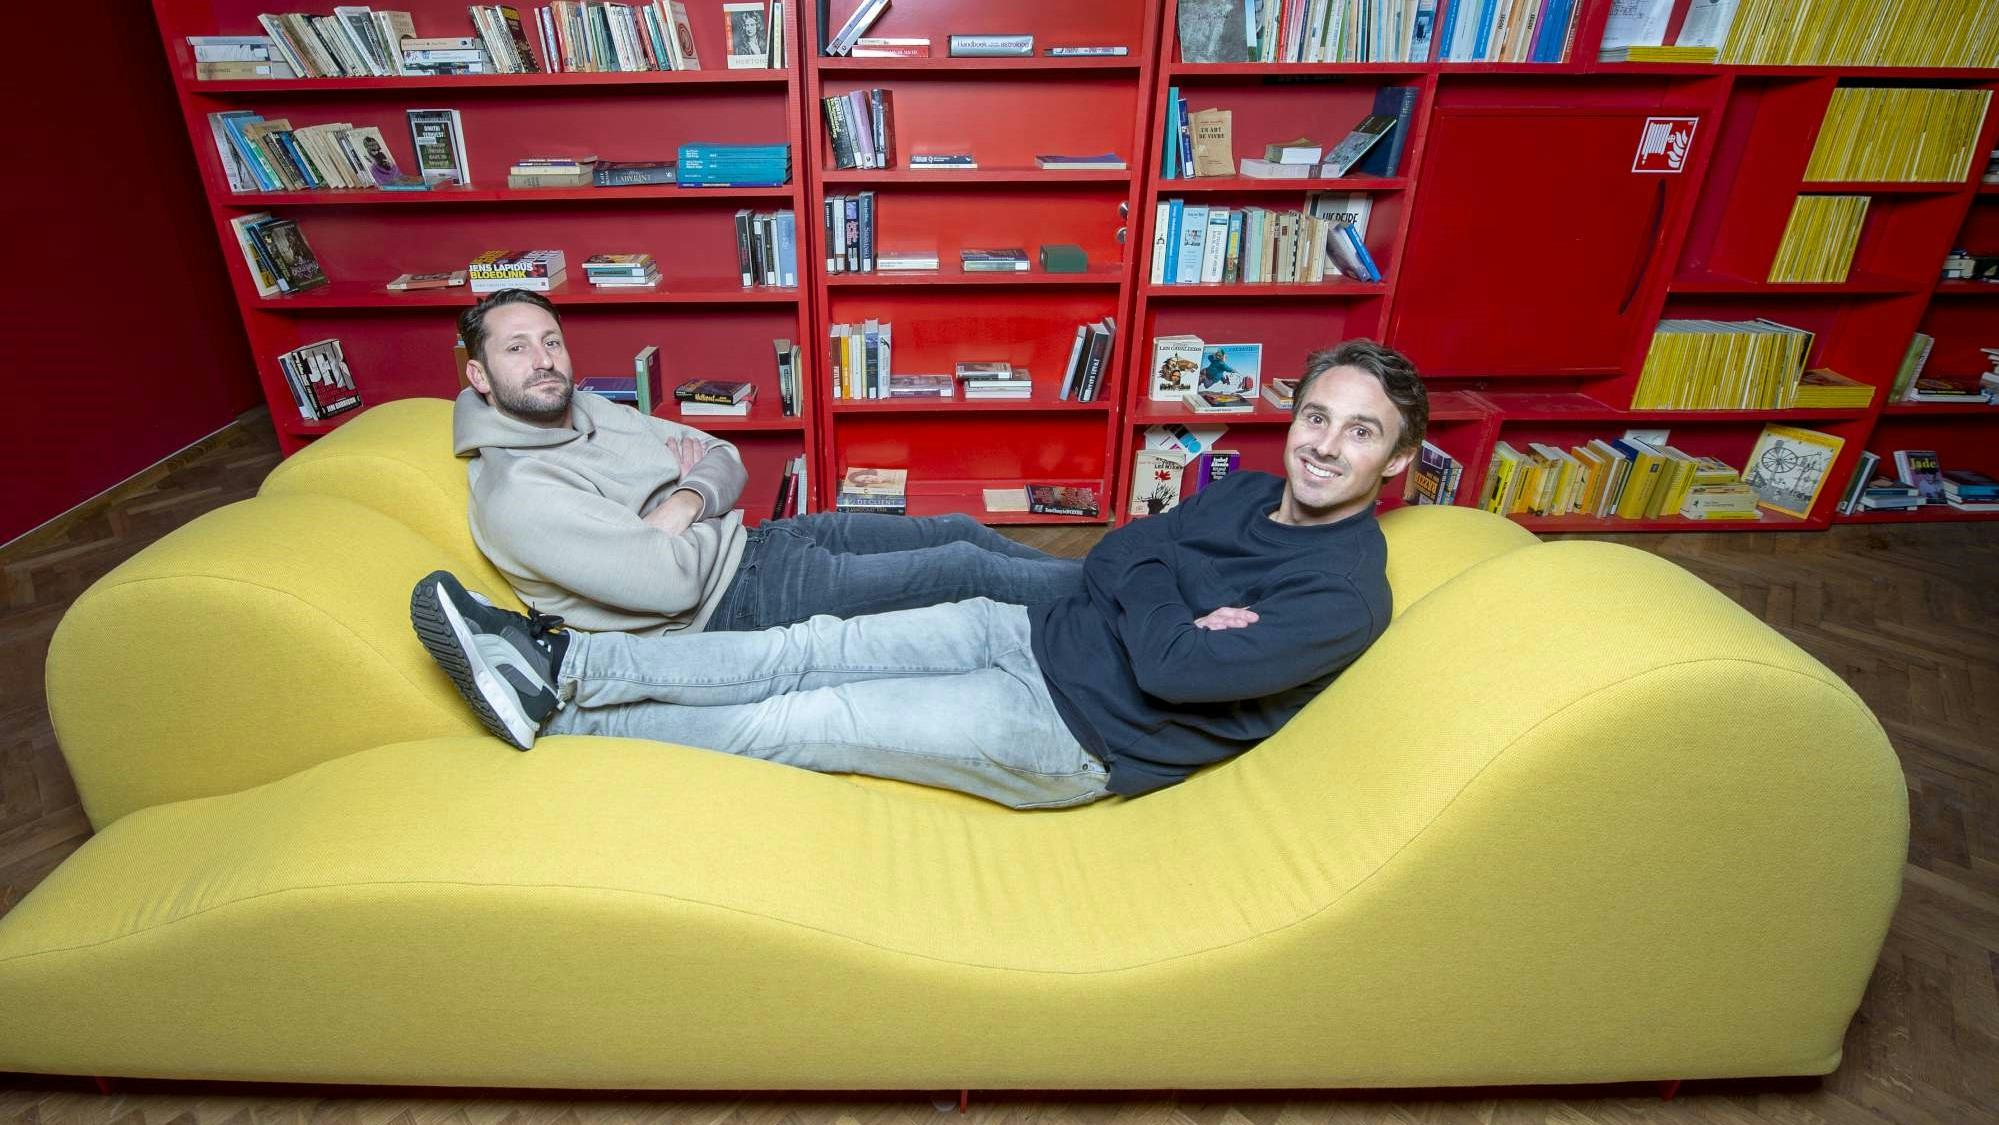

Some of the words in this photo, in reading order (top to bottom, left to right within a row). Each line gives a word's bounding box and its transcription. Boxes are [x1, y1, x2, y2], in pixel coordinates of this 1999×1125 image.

[469, 263, 493, 272] JENS
[493, 261, 534, 272] LAPIDUS
[470, 270, 527, 279] BLOEDLINK
[1910, 457, 1937, 470] Jade
